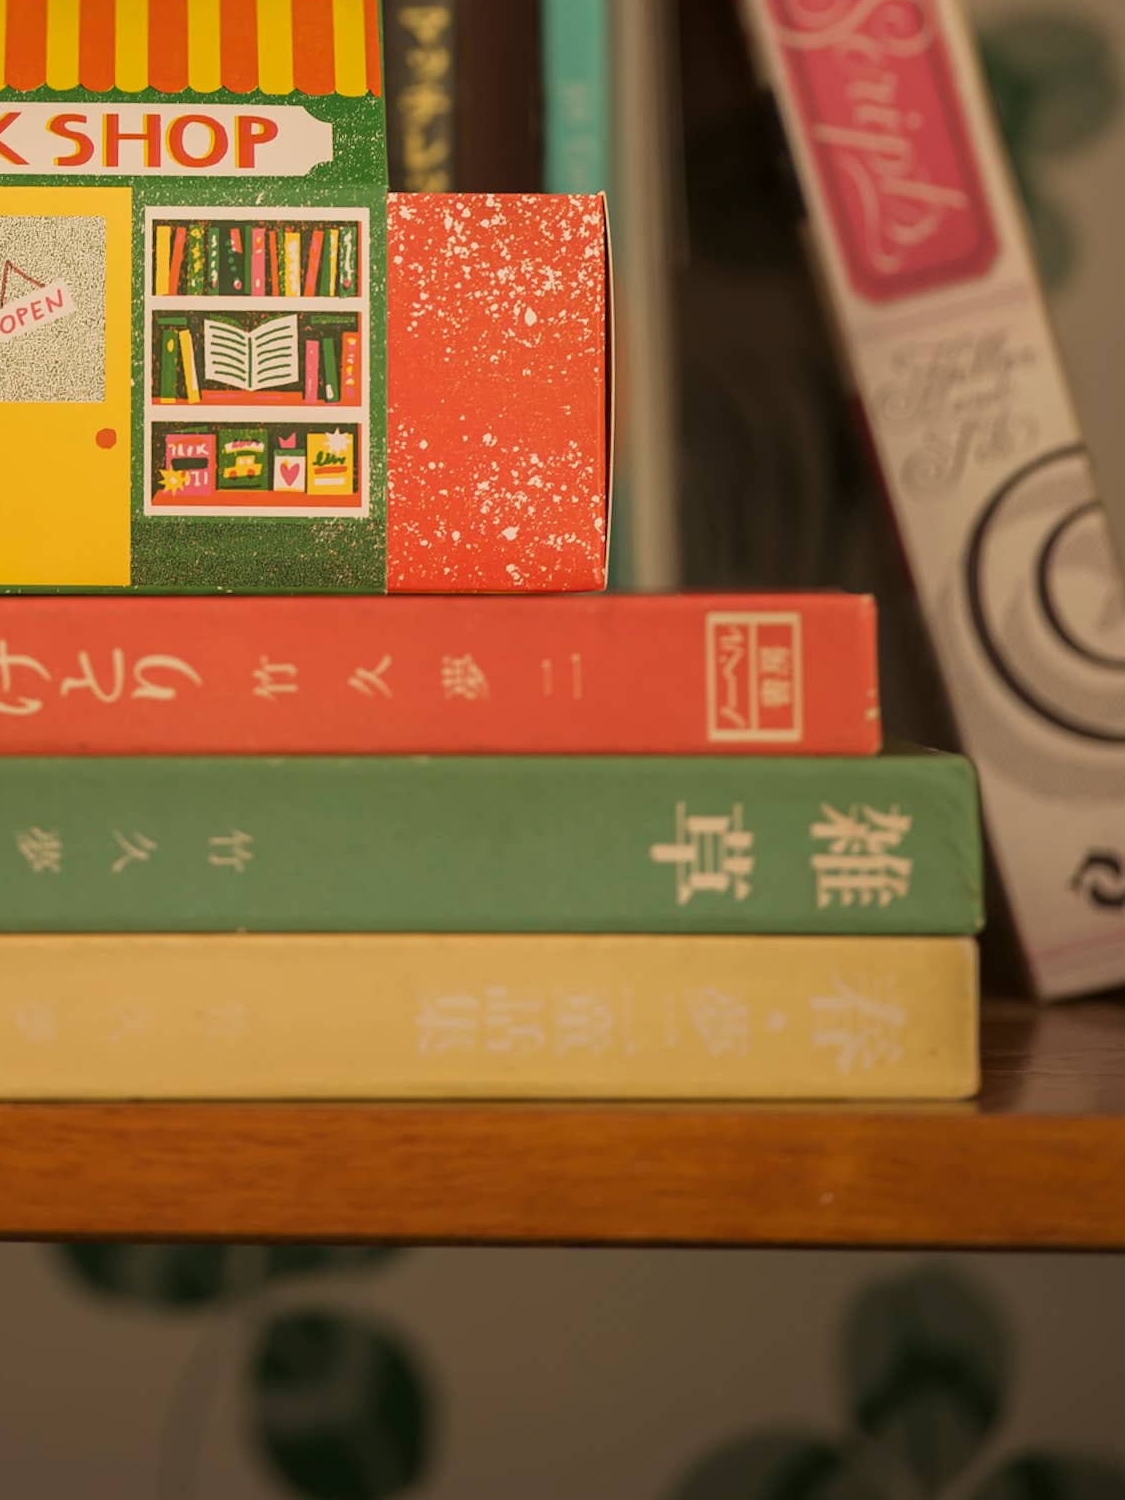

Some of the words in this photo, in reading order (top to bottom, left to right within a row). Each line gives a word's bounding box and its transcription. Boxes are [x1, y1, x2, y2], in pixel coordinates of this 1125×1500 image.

[46, 113, 279, 169] SHOP
[0, 289, 63, 334] OPEN
[251, 653, 584, 700] 竹久夢二
[717, 625, 748, 730] ノーベル
[649, 802, 914, 909] 雑草
